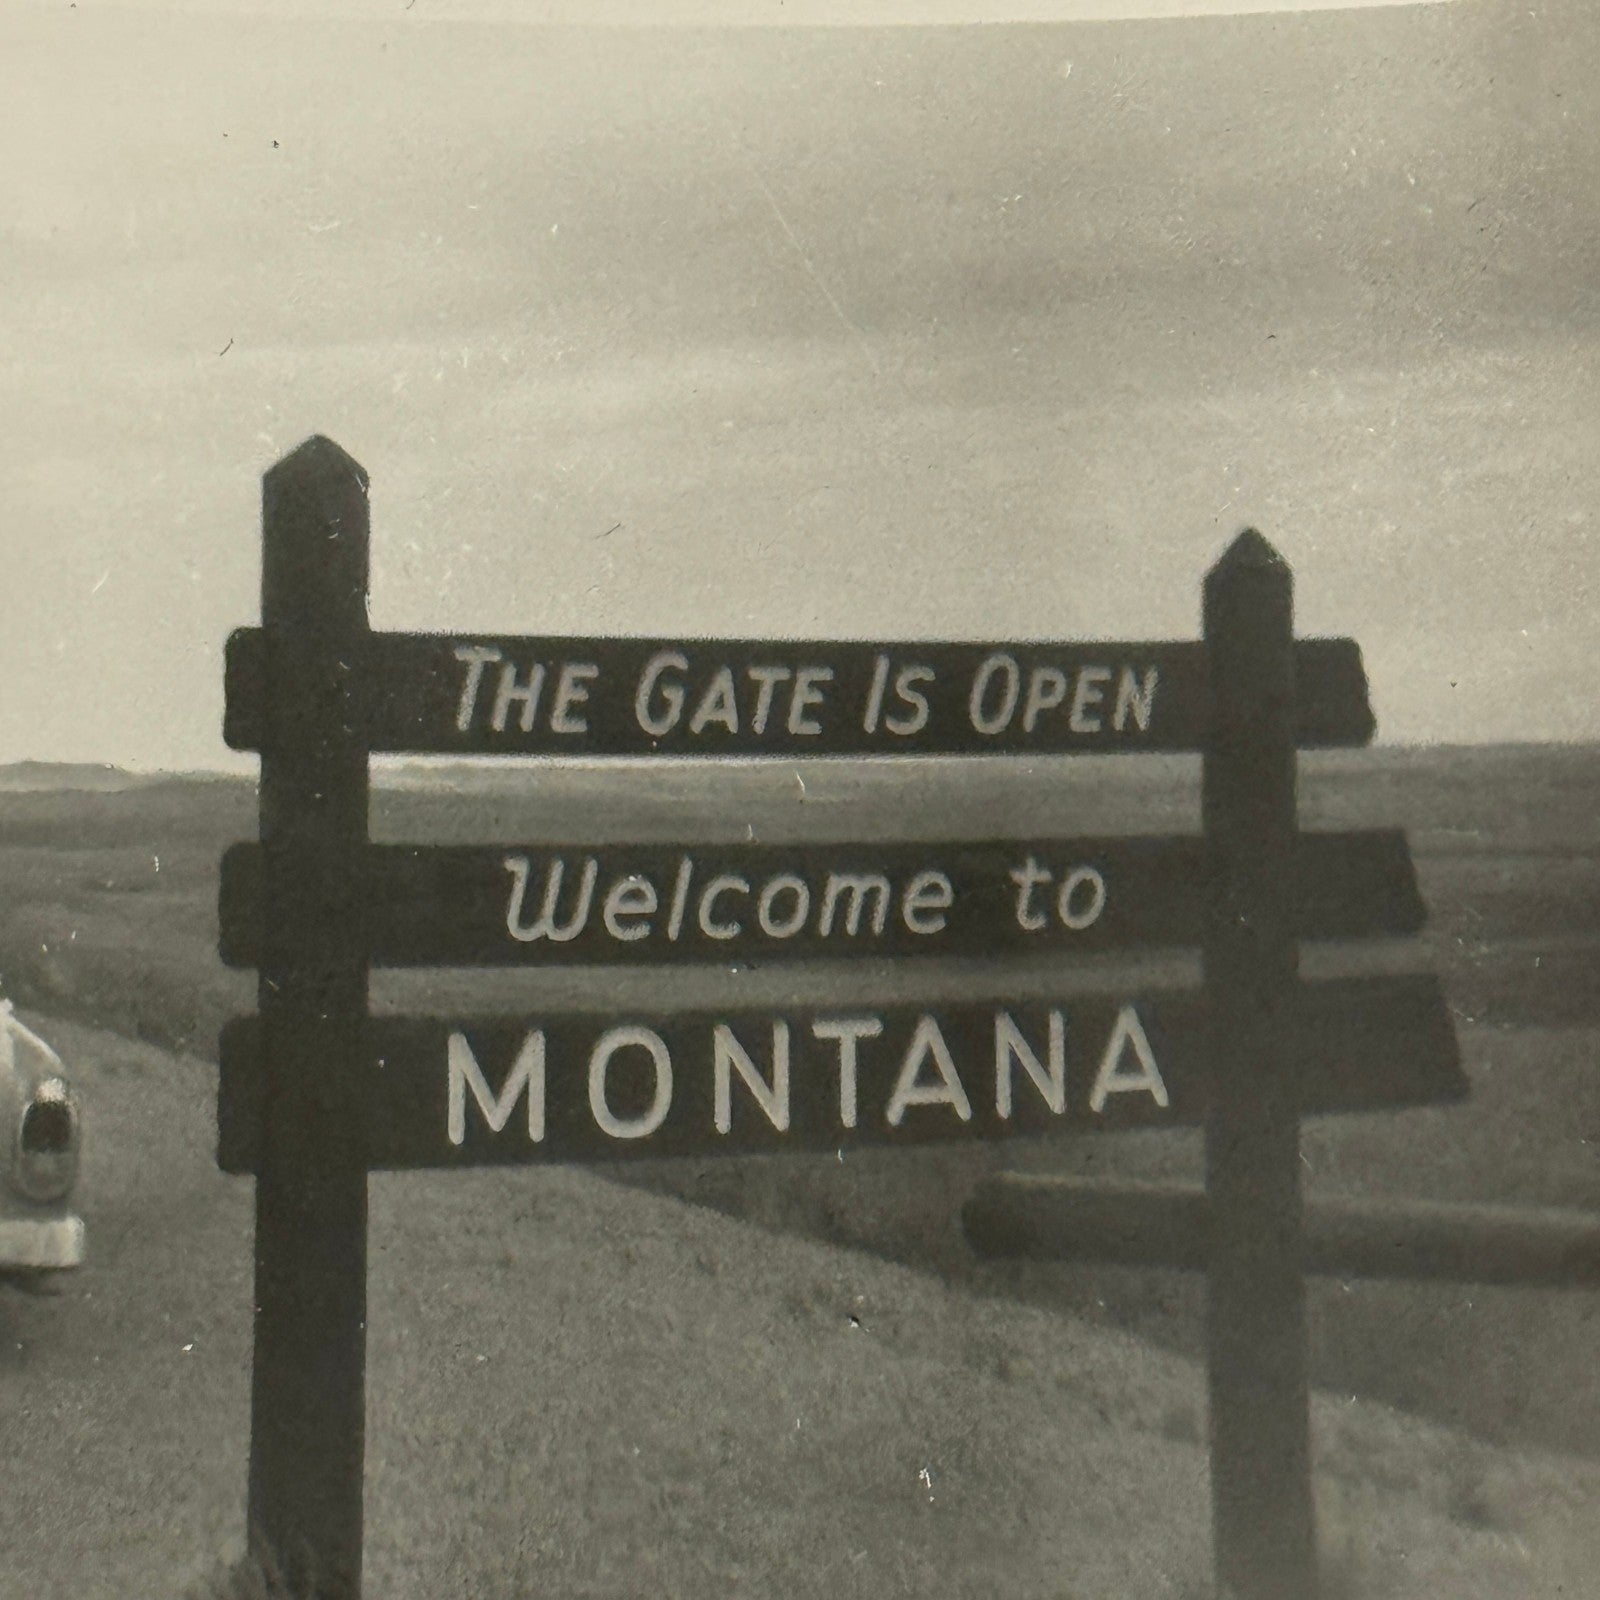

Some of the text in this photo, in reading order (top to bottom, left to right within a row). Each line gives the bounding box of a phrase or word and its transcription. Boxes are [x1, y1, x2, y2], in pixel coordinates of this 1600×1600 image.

[453, 645, 1160, 737] THE GATE IS OPEN
[503, 857, 1107, 943] Welcome to
[446, 1005, 1170, 1146] MONTANA
